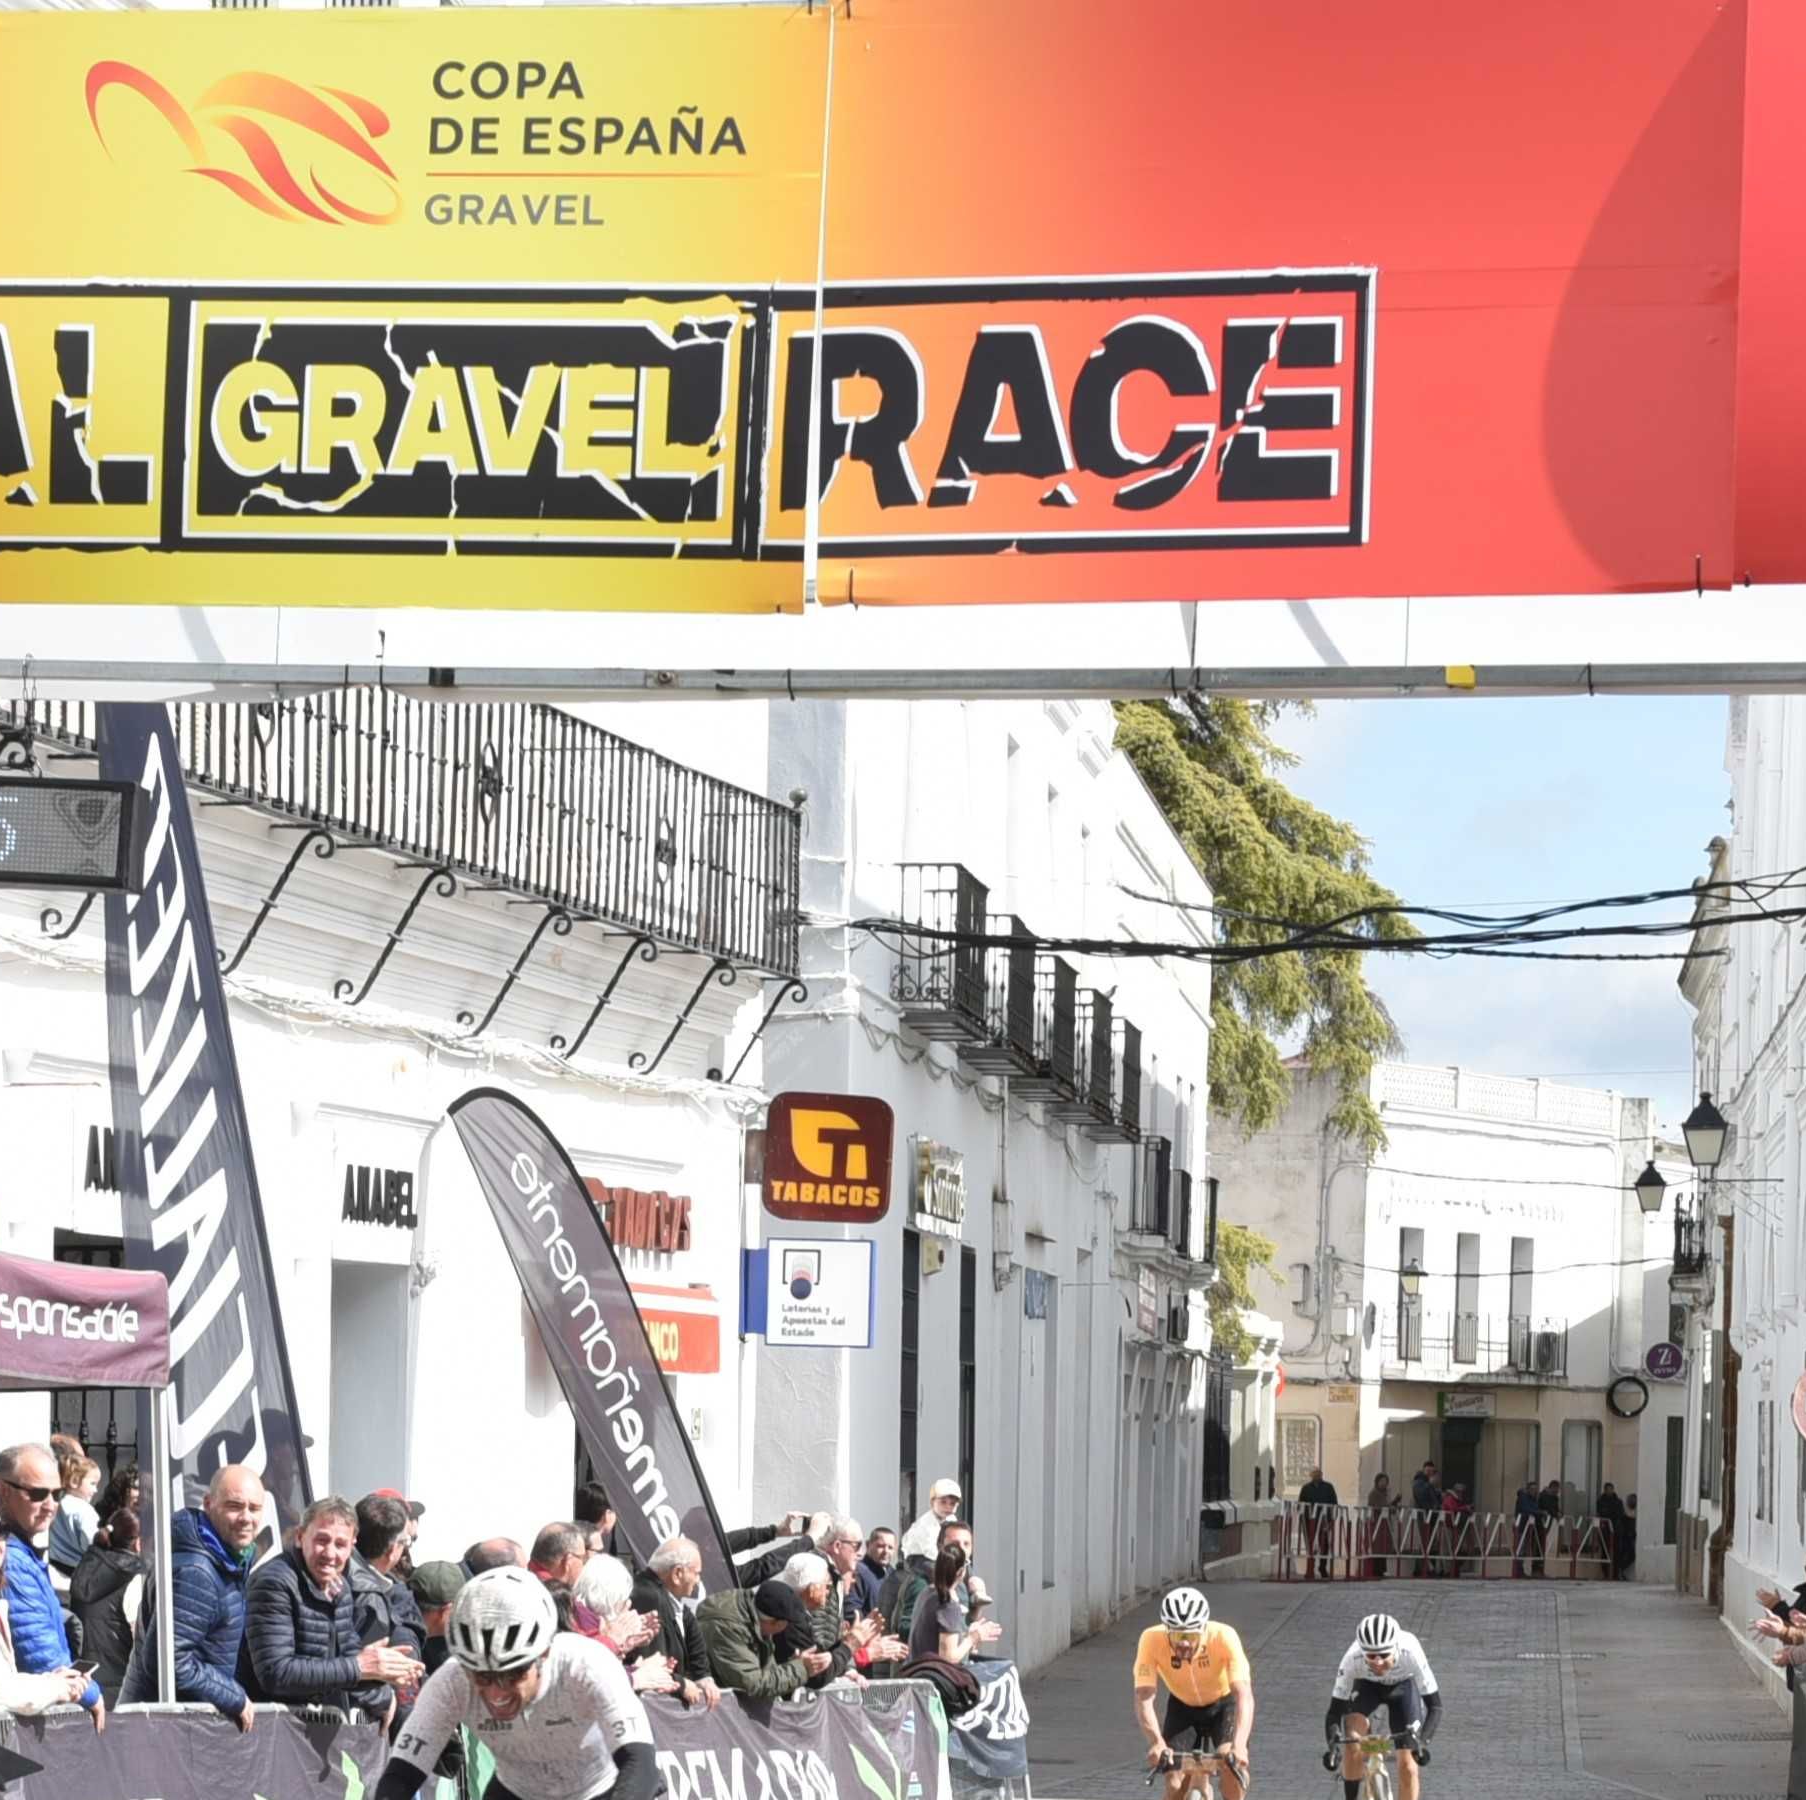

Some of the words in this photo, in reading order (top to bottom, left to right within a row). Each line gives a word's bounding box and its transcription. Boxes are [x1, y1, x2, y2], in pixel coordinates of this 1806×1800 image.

[431, 60, 585, 101] COPA
[428, 117, 500, 156] DE
[522, 105, 748, 156] ESPAÑA
[423, 193, 605, 226] GRAVEL
[207, 353, 723, 484] GRAVEL
[778, 314, 1351, 515] RACE
[341, 1163, 418, 1228] ANABEL
[771, 1179, 881, 1208] TABACOS
[397, 1733, 428, 1757] 3T
